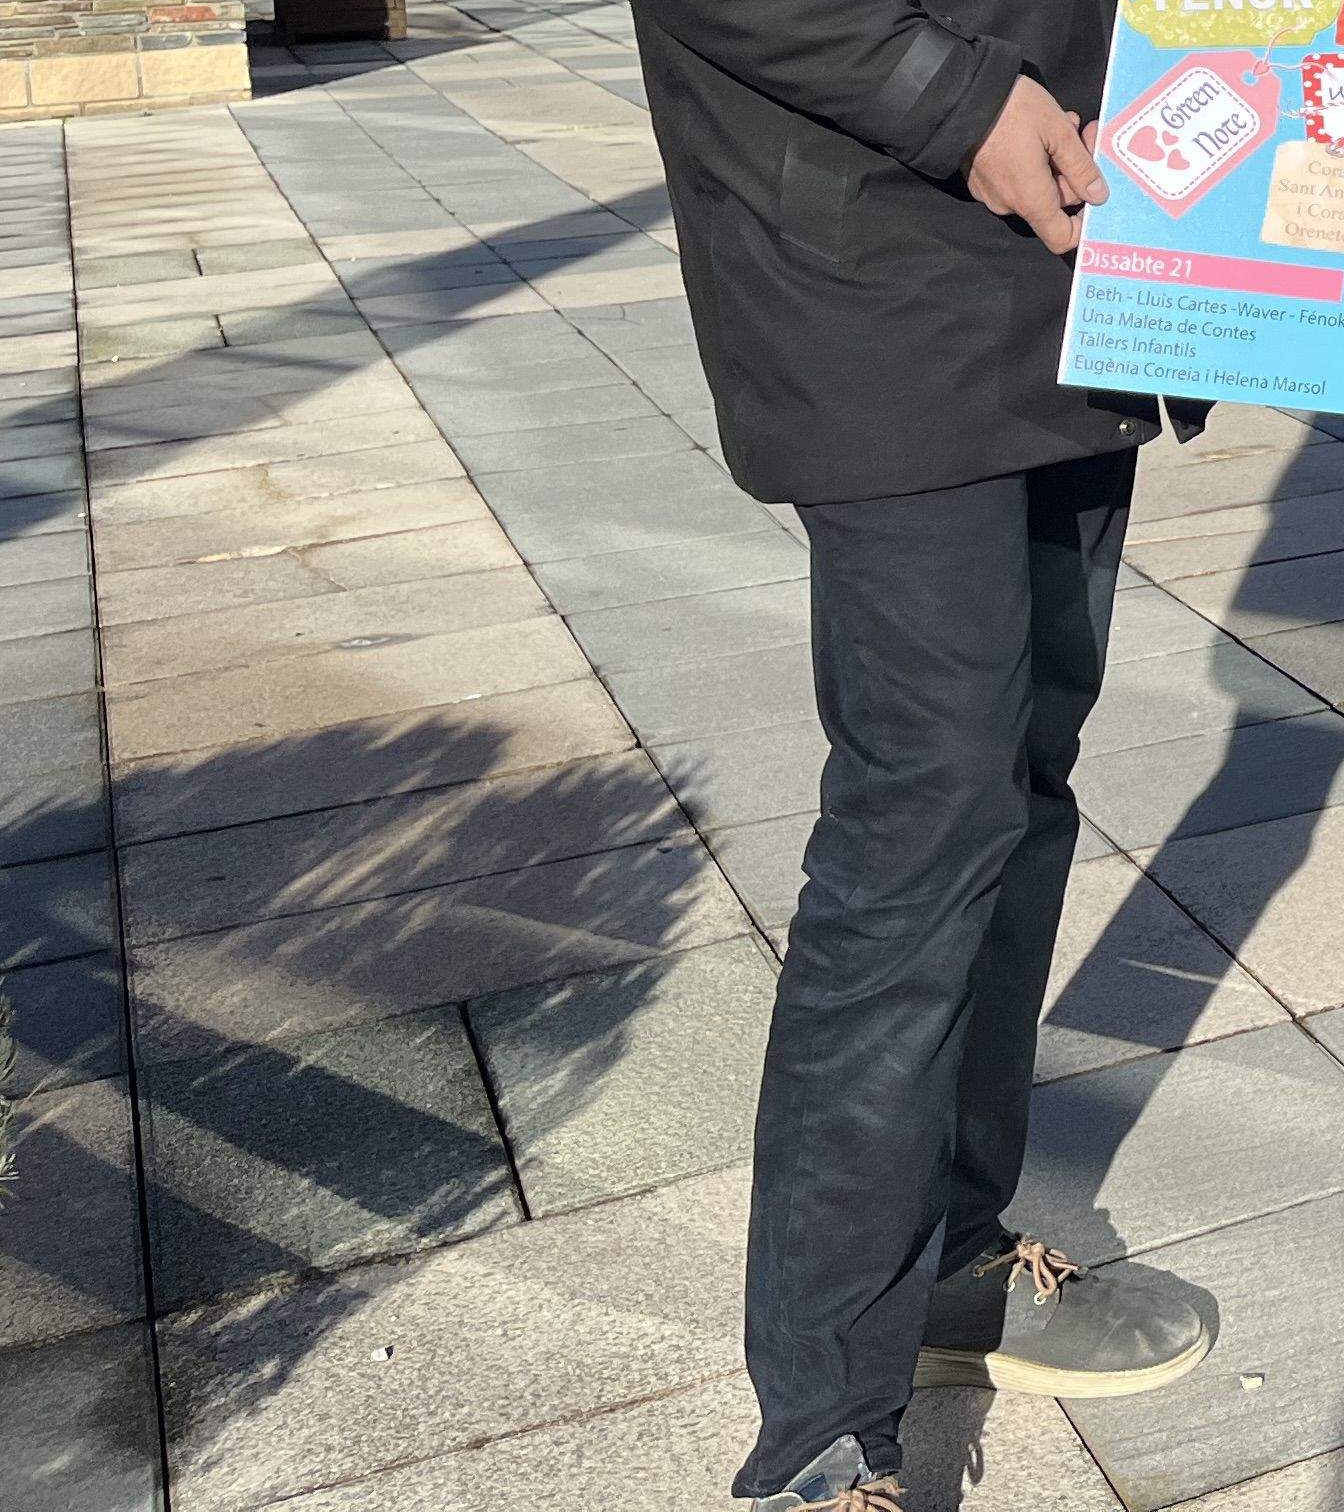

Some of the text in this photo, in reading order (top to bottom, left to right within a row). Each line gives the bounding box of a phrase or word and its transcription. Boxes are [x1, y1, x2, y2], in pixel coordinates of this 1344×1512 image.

[1159, 81, 1220, 130] Green
[1191, 112, 1247, 159] Note
[1277, 178, 1322, 197] Sant
[1296, 201, 1302, 216] i
[1078, 245, 1193, 278] Dissabte 21
[1084, 284, 1122, 302] Beth
[1176, 294, 1227, 315] Cartes
[1081, 307, 1257, 341] Una Maleta de Contes
[1077, 330, 1197, 358] Tallers Infantils
[1143, 361, 1200, 382] Correia
[1204, 368, 1210, 383] i
[1213, 369, 1269, 389] Helena
[1272, 375, 1326, 395] Marsol
